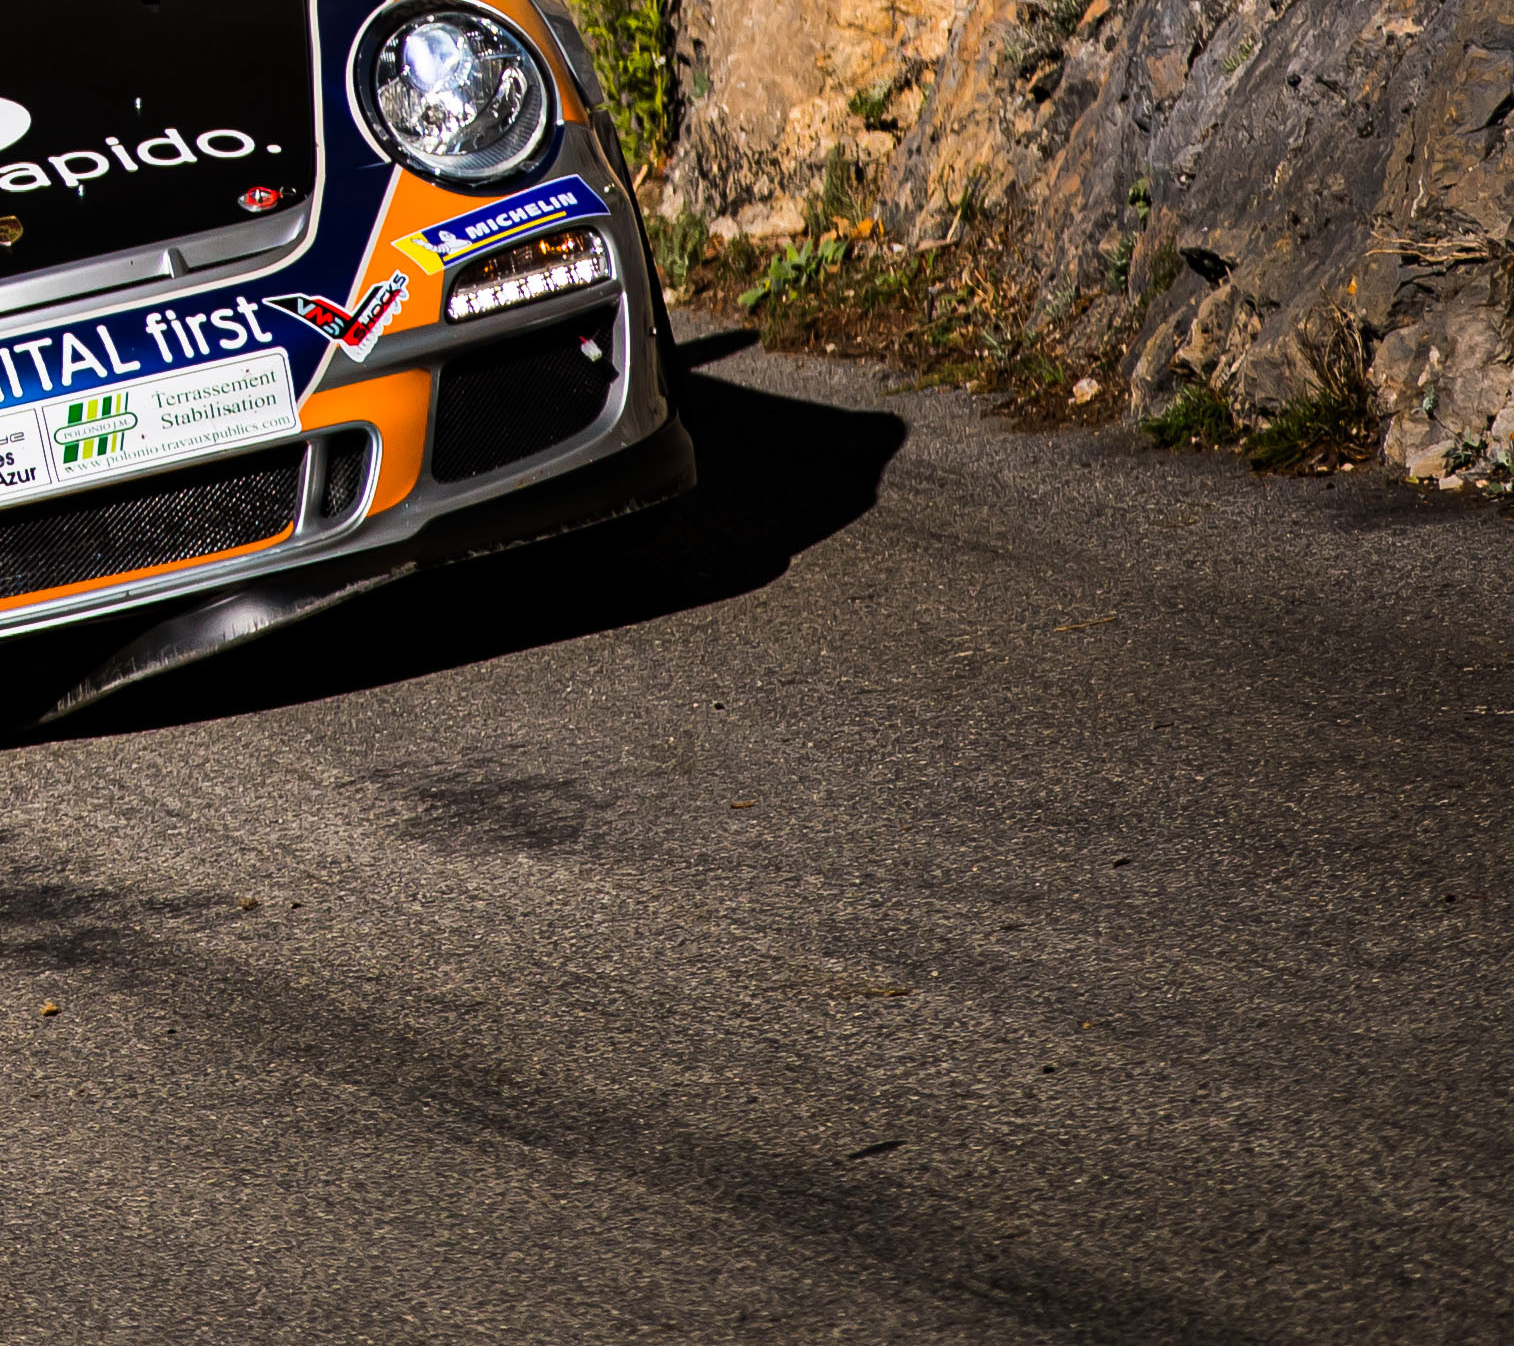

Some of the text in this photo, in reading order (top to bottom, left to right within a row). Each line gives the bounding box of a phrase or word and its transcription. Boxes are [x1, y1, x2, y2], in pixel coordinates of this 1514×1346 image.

[463, 191, 579, 241] MICHELIN
[145, 295, 273, 364] first
[352, 273, 406, 343] SHOCKS
[150, 368, 278, 411] Terrassement
[160, 390, 279, 431] Stabilisation
[62, 420, 109, 442] POLONIO
